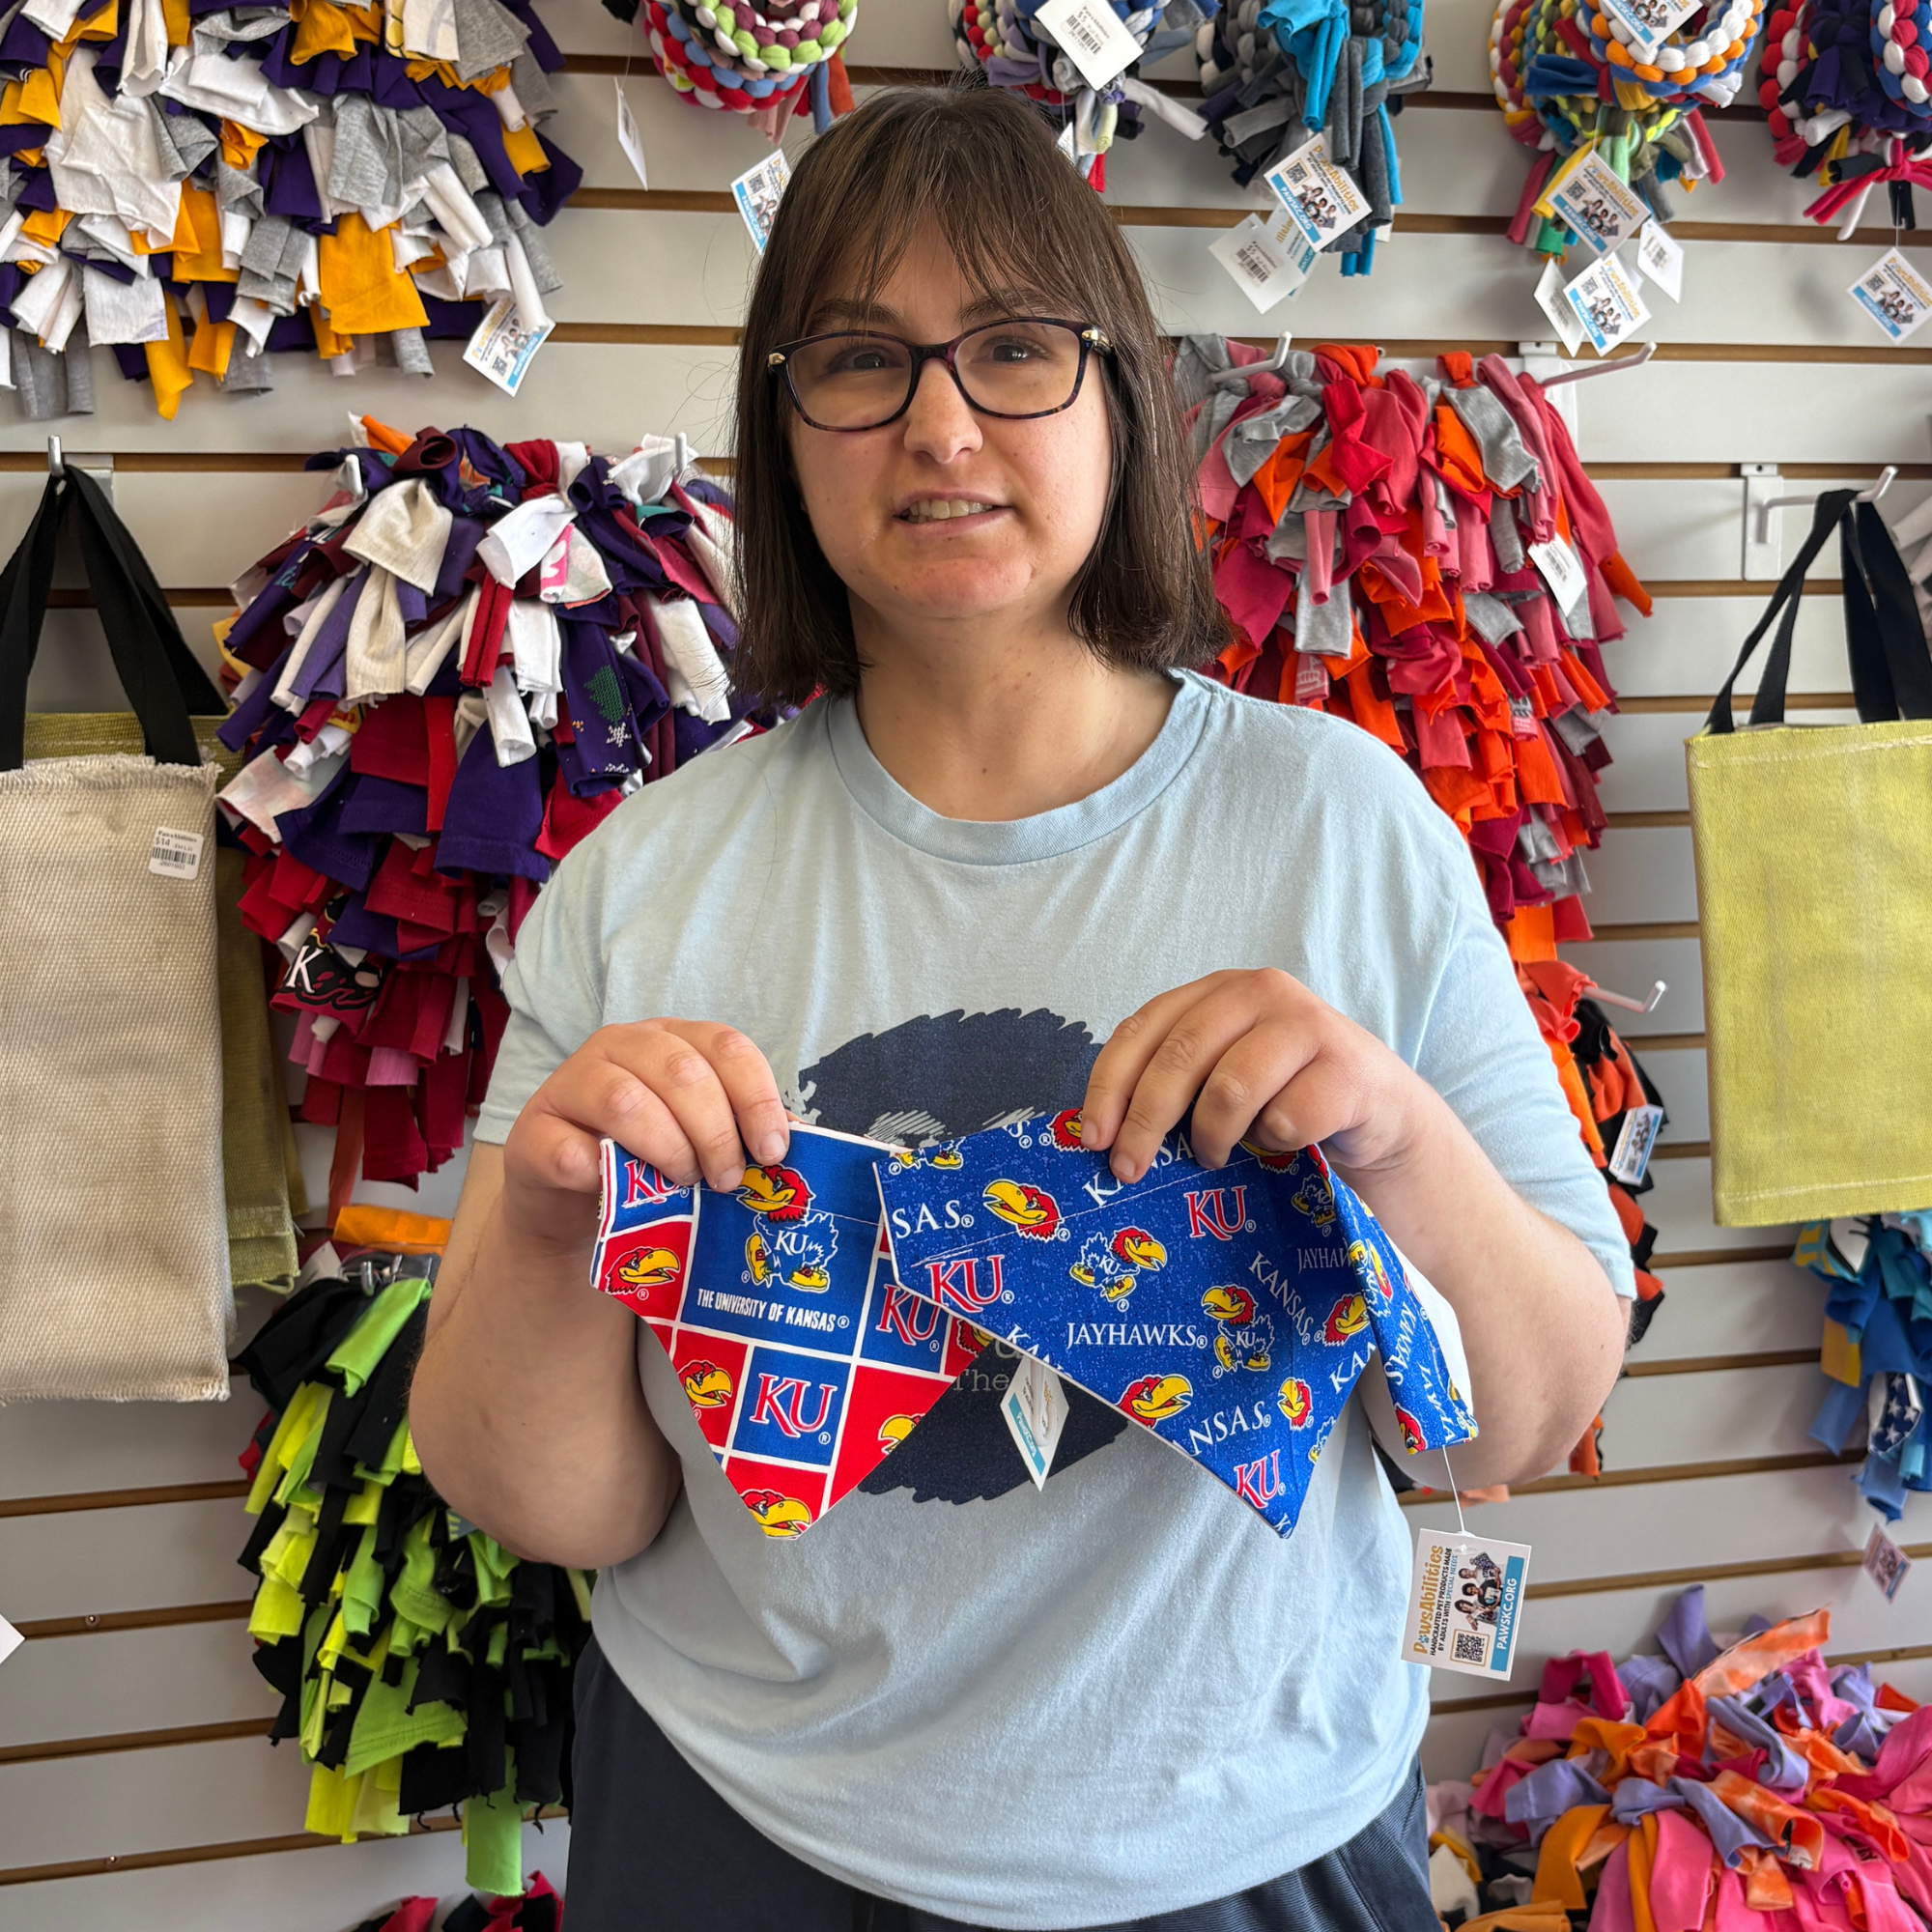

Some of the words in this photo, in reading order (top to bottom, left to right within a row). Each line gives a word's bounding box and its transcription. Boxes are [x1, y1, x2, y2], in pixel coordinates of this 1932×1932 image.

[1280, 185, 1313, 231] PAWSKC.ORG
[156, 837, 170, 847] $14
[622, 1159, 679, 1208] KU
[1183, 1185, 1247, 1241] KU
[775, 1230, 810, 1256] KU
[925, 1255, 1006, 1313] KU
[1248, 1251, 1314, 1338] KANSAS
[697, 1289, 714, 1308] THE
[715, 1291, 767, 1320] UNIVERSITY
[768, 1303, 785, 1323] OF
[785, 1305, 837, 1333] KANSAS
[876, 1284, 940, 1346] KU
[1066, 1321, 1197, 1350] JAYHAWKS
[1236, 1330, 1257, 1346] KU
[952, 1369, 1010, 1392] The
[750, 1373, 838, 1438] KU
[1183, 1401, 1266, 1457] NSAS
[1234, 1449, 1281, 1509] KU
[1443, 1548, 1452, 1566] MADE
[1449, 1554, 1459, 1575] NEEDS
[1438, 1566, 1449, 1599] PRODUCTS
[1445, 1576, 1455, 1600] SPECIAL
[1442, 1601, 1451, 1617] WITH
[1496, 1577, 1518, 1650] PAWSKC.ORG
[1429, 1611, 1442, 1656] HANDCRAFTED
[1437, 1642, 1444, 1651] BY
[1438, 1618, 1448, 1642] ADULTS
